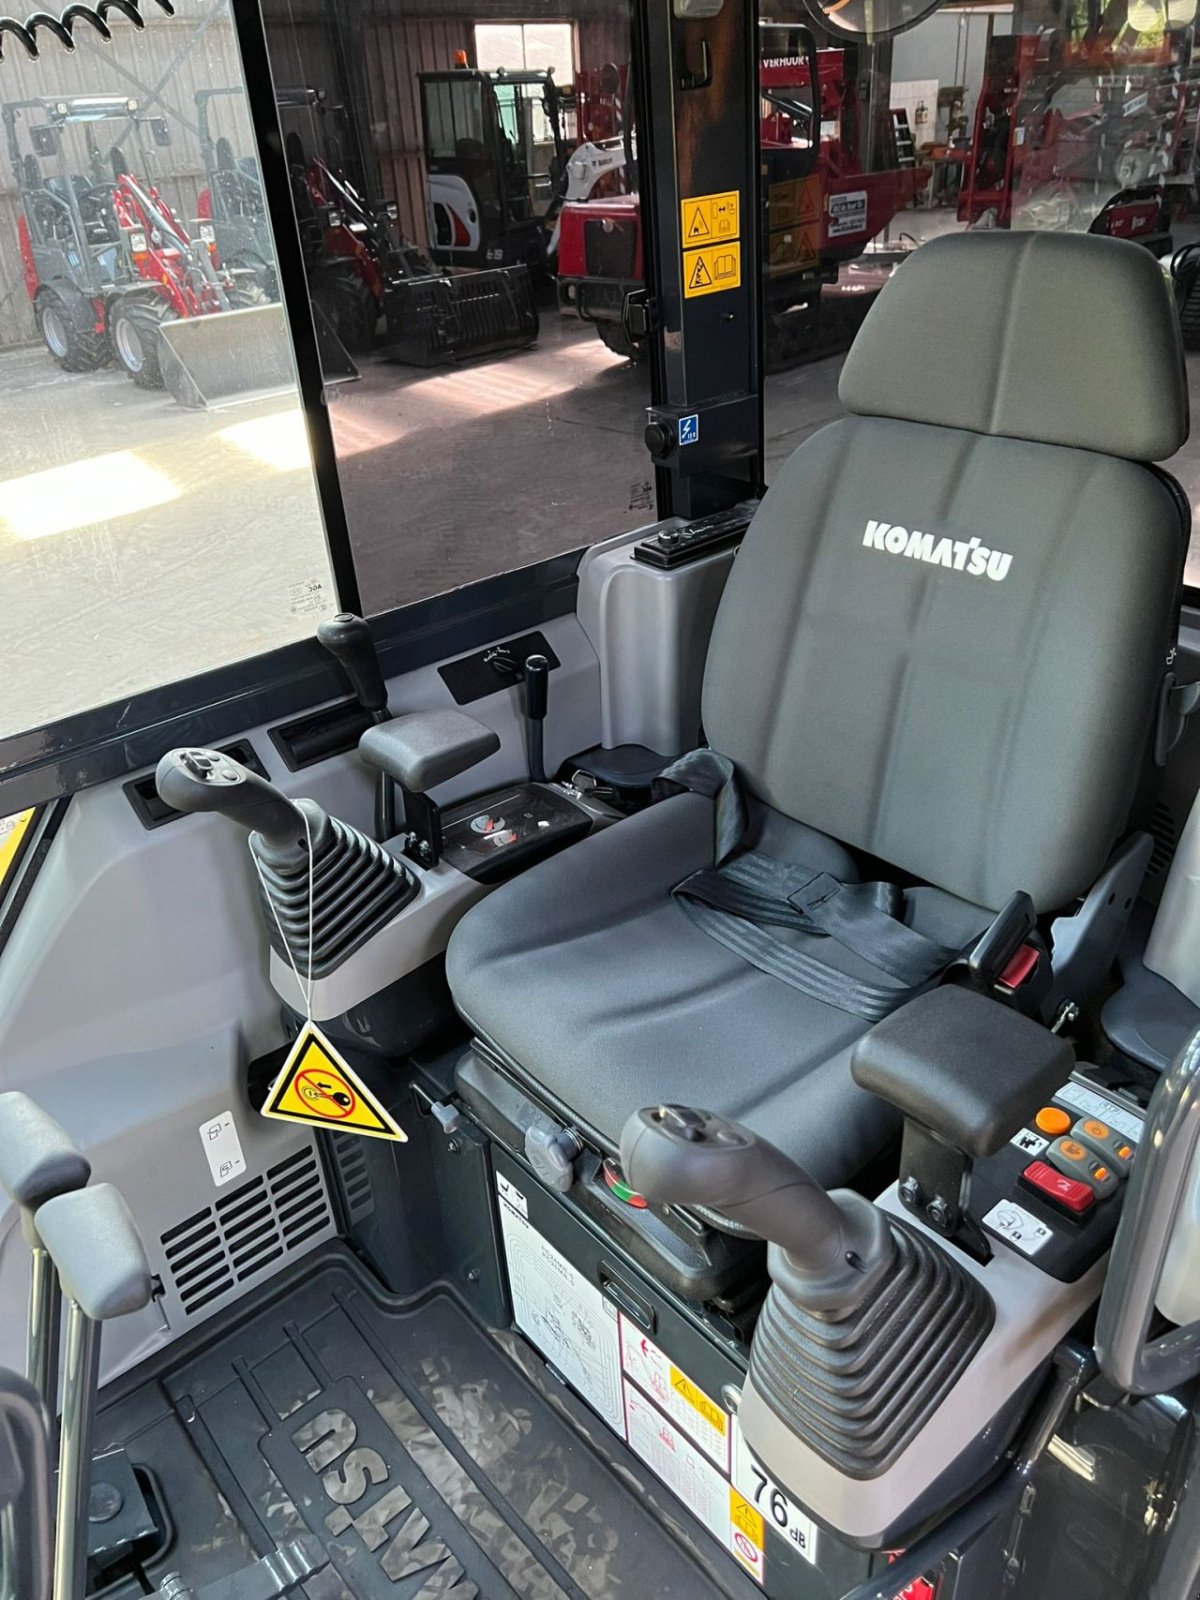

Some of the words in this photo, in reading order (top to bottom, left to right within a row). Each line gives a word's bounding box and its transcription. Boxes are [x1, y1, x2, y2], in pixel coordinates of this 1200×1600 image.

[862, 520, 1013, 581] KOMATSU
[751, 1463, 788, 1527] 76
[789, 1527, 806, 1549] dB
